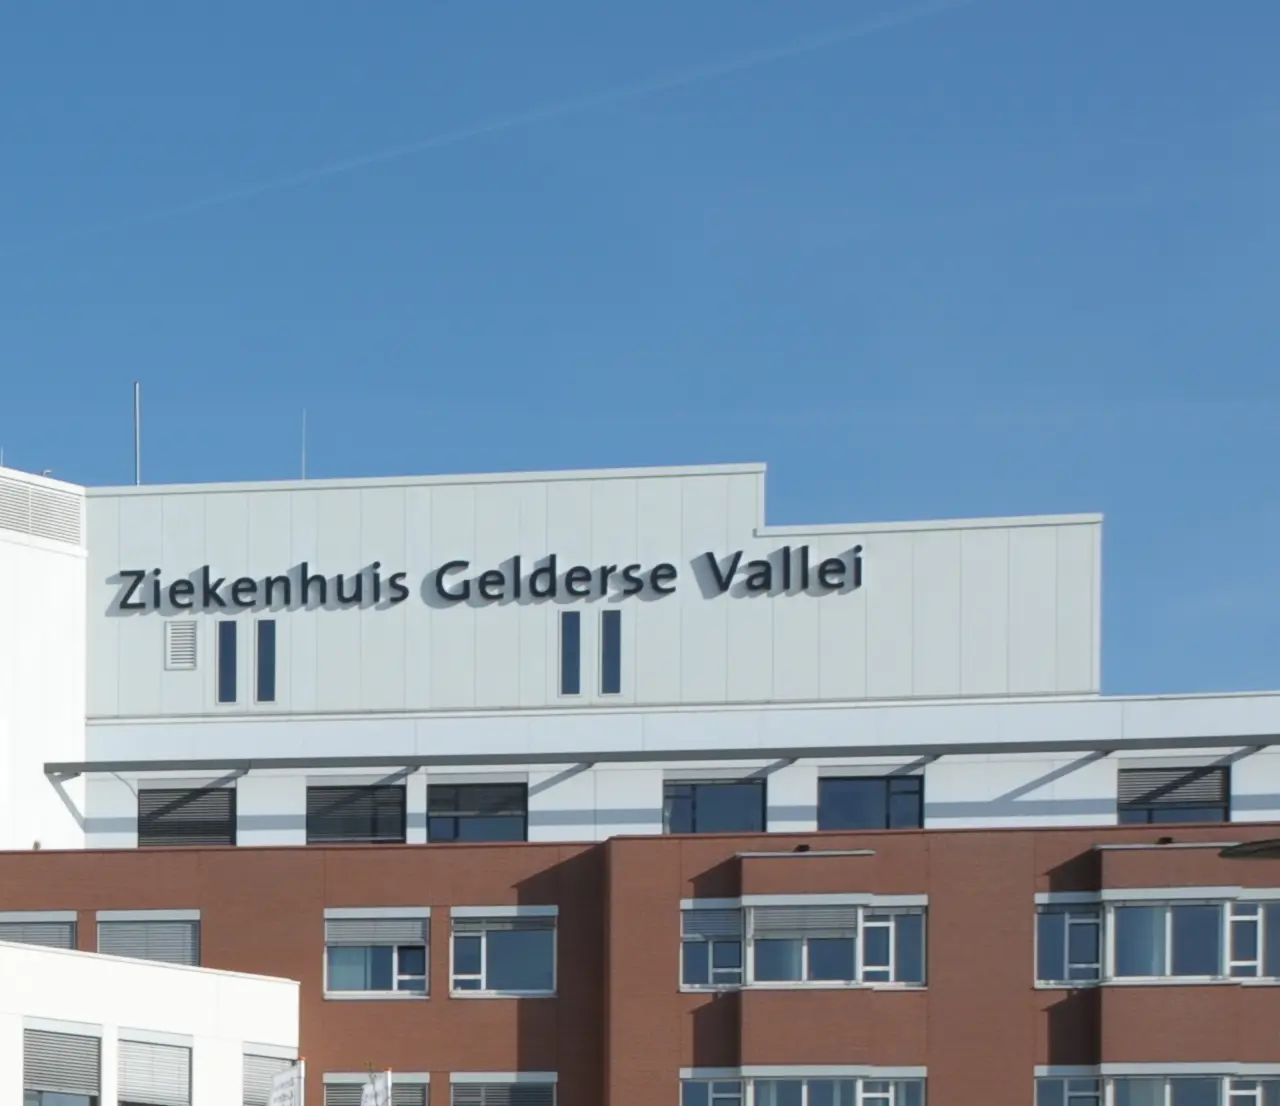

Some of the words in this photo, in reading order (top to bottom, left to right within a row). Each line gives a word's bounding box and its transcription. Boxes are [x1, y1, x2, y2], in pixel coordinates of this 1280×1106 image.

[119, 561, 409, 610] Ziekenhuis
[435, 553, 677, 602] Gelderse
[704, 544, 863, 594] Vallei
